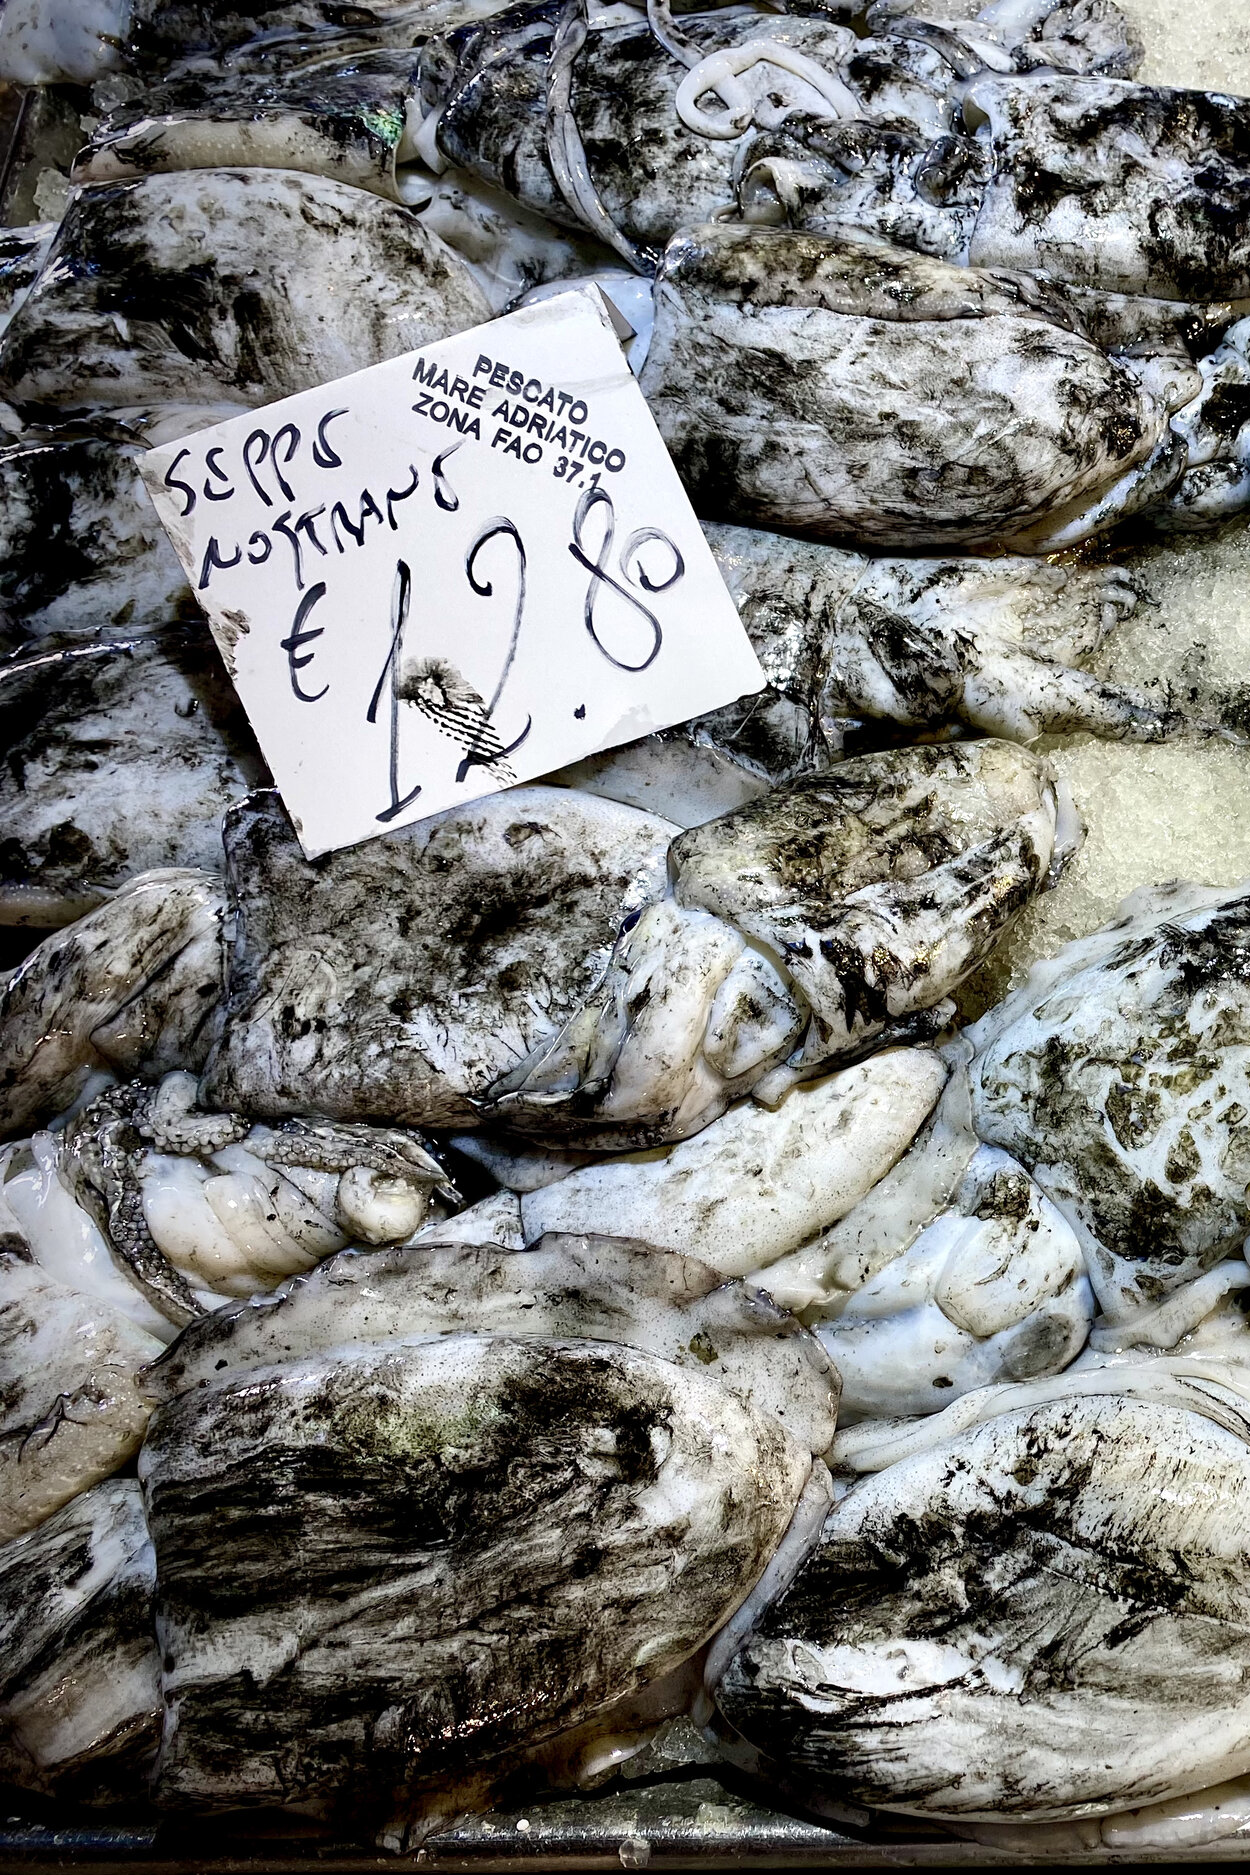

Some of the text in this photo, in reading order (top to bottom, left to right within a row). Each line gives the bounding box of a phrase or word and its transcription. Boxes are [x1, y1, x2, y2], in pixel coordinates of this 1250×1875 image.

[412, 357, 626, 473] MARE ADRIATICO
[472, 354, 588, 425] PESCATO
[411, 392, 602, 493] ZONA FAO 37.1
